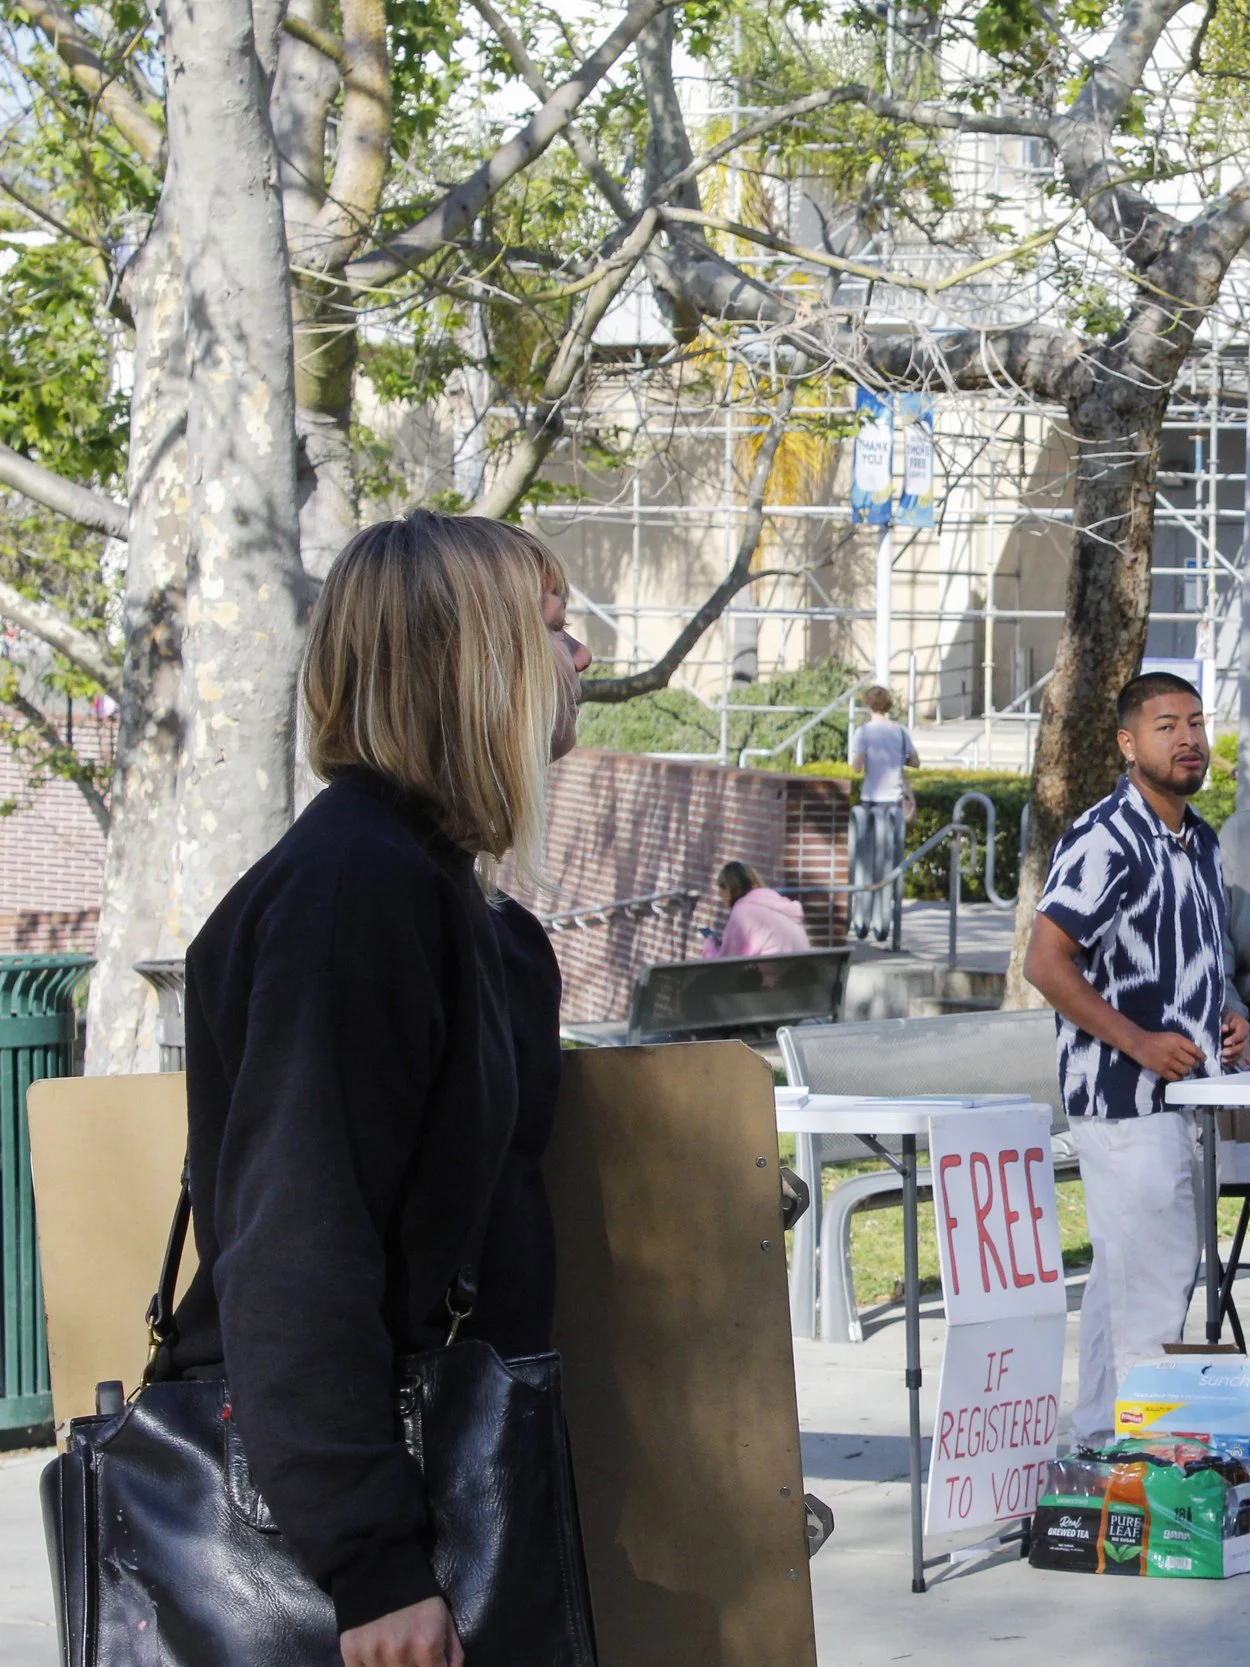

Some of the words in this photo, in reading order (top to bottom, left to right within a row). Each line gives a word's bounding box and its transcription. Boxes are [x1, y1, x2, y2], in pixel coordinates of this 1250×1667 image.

[858, 439, 889, 452] THANK
[939, 1147, 1059, 1296] FREE
[984, 1348, 1014, 1392] IF
[938, 1394, 1057, 1460] REGISTERED
[946, 1475, 973, 1519] TO
[992, 1460, 1046, 1515] VOTE
[1111, 1514, 1142, 1527] PURE
[1175, 1508, 1186, 1520] 18
[1060, 1516, 1082, 1528] Real
[1048, 1528, 1076, 1538] BREWED
[1077, 1529, 1089, 1539] TEA
